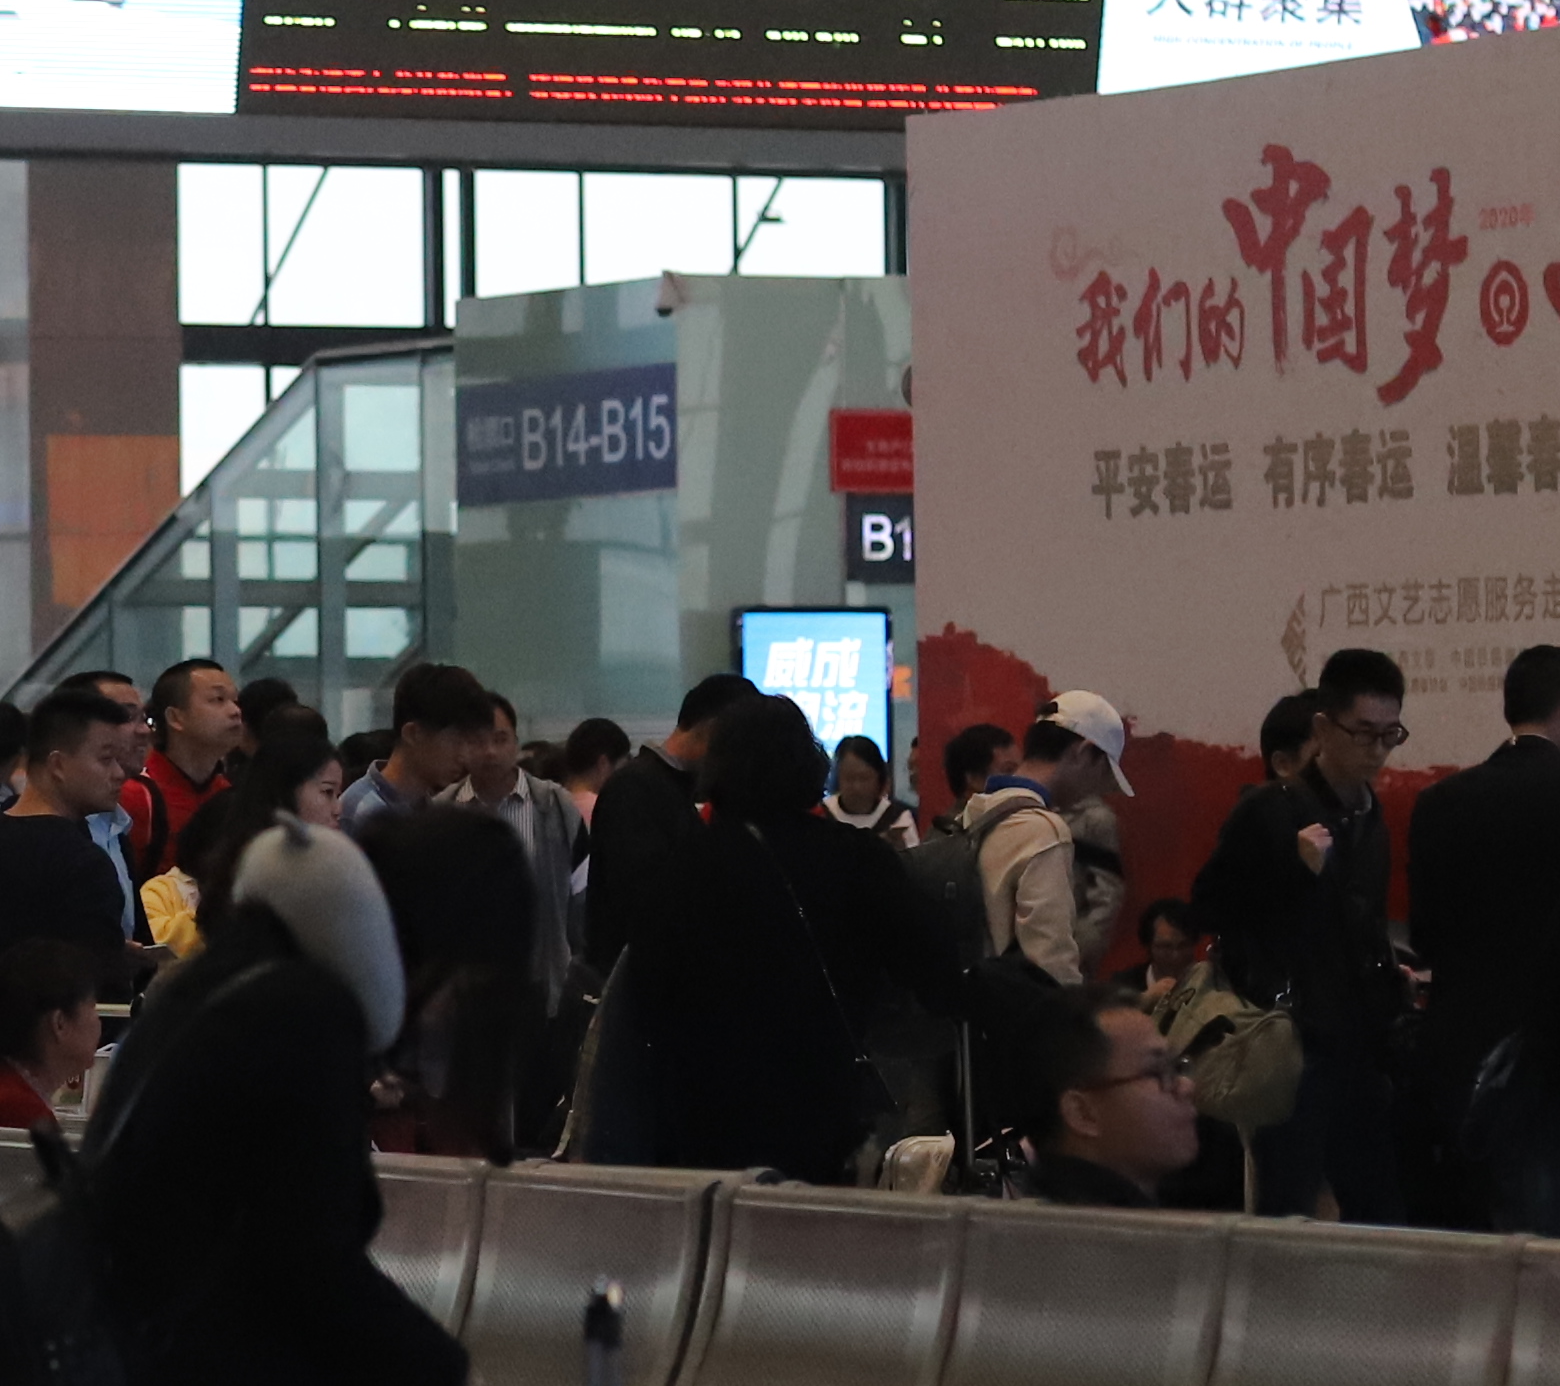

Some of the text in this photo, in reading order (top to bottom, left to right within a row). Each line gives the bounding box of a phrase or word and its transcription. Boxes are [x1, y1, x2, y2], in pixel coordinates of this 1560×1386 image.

[523, 394, 670, 470] B14-B15
[1092, 442, 1234, 520] 平安春运
[1263, 429, 1414, 510] 有序春运
[862, 513, 913, 562] B1
